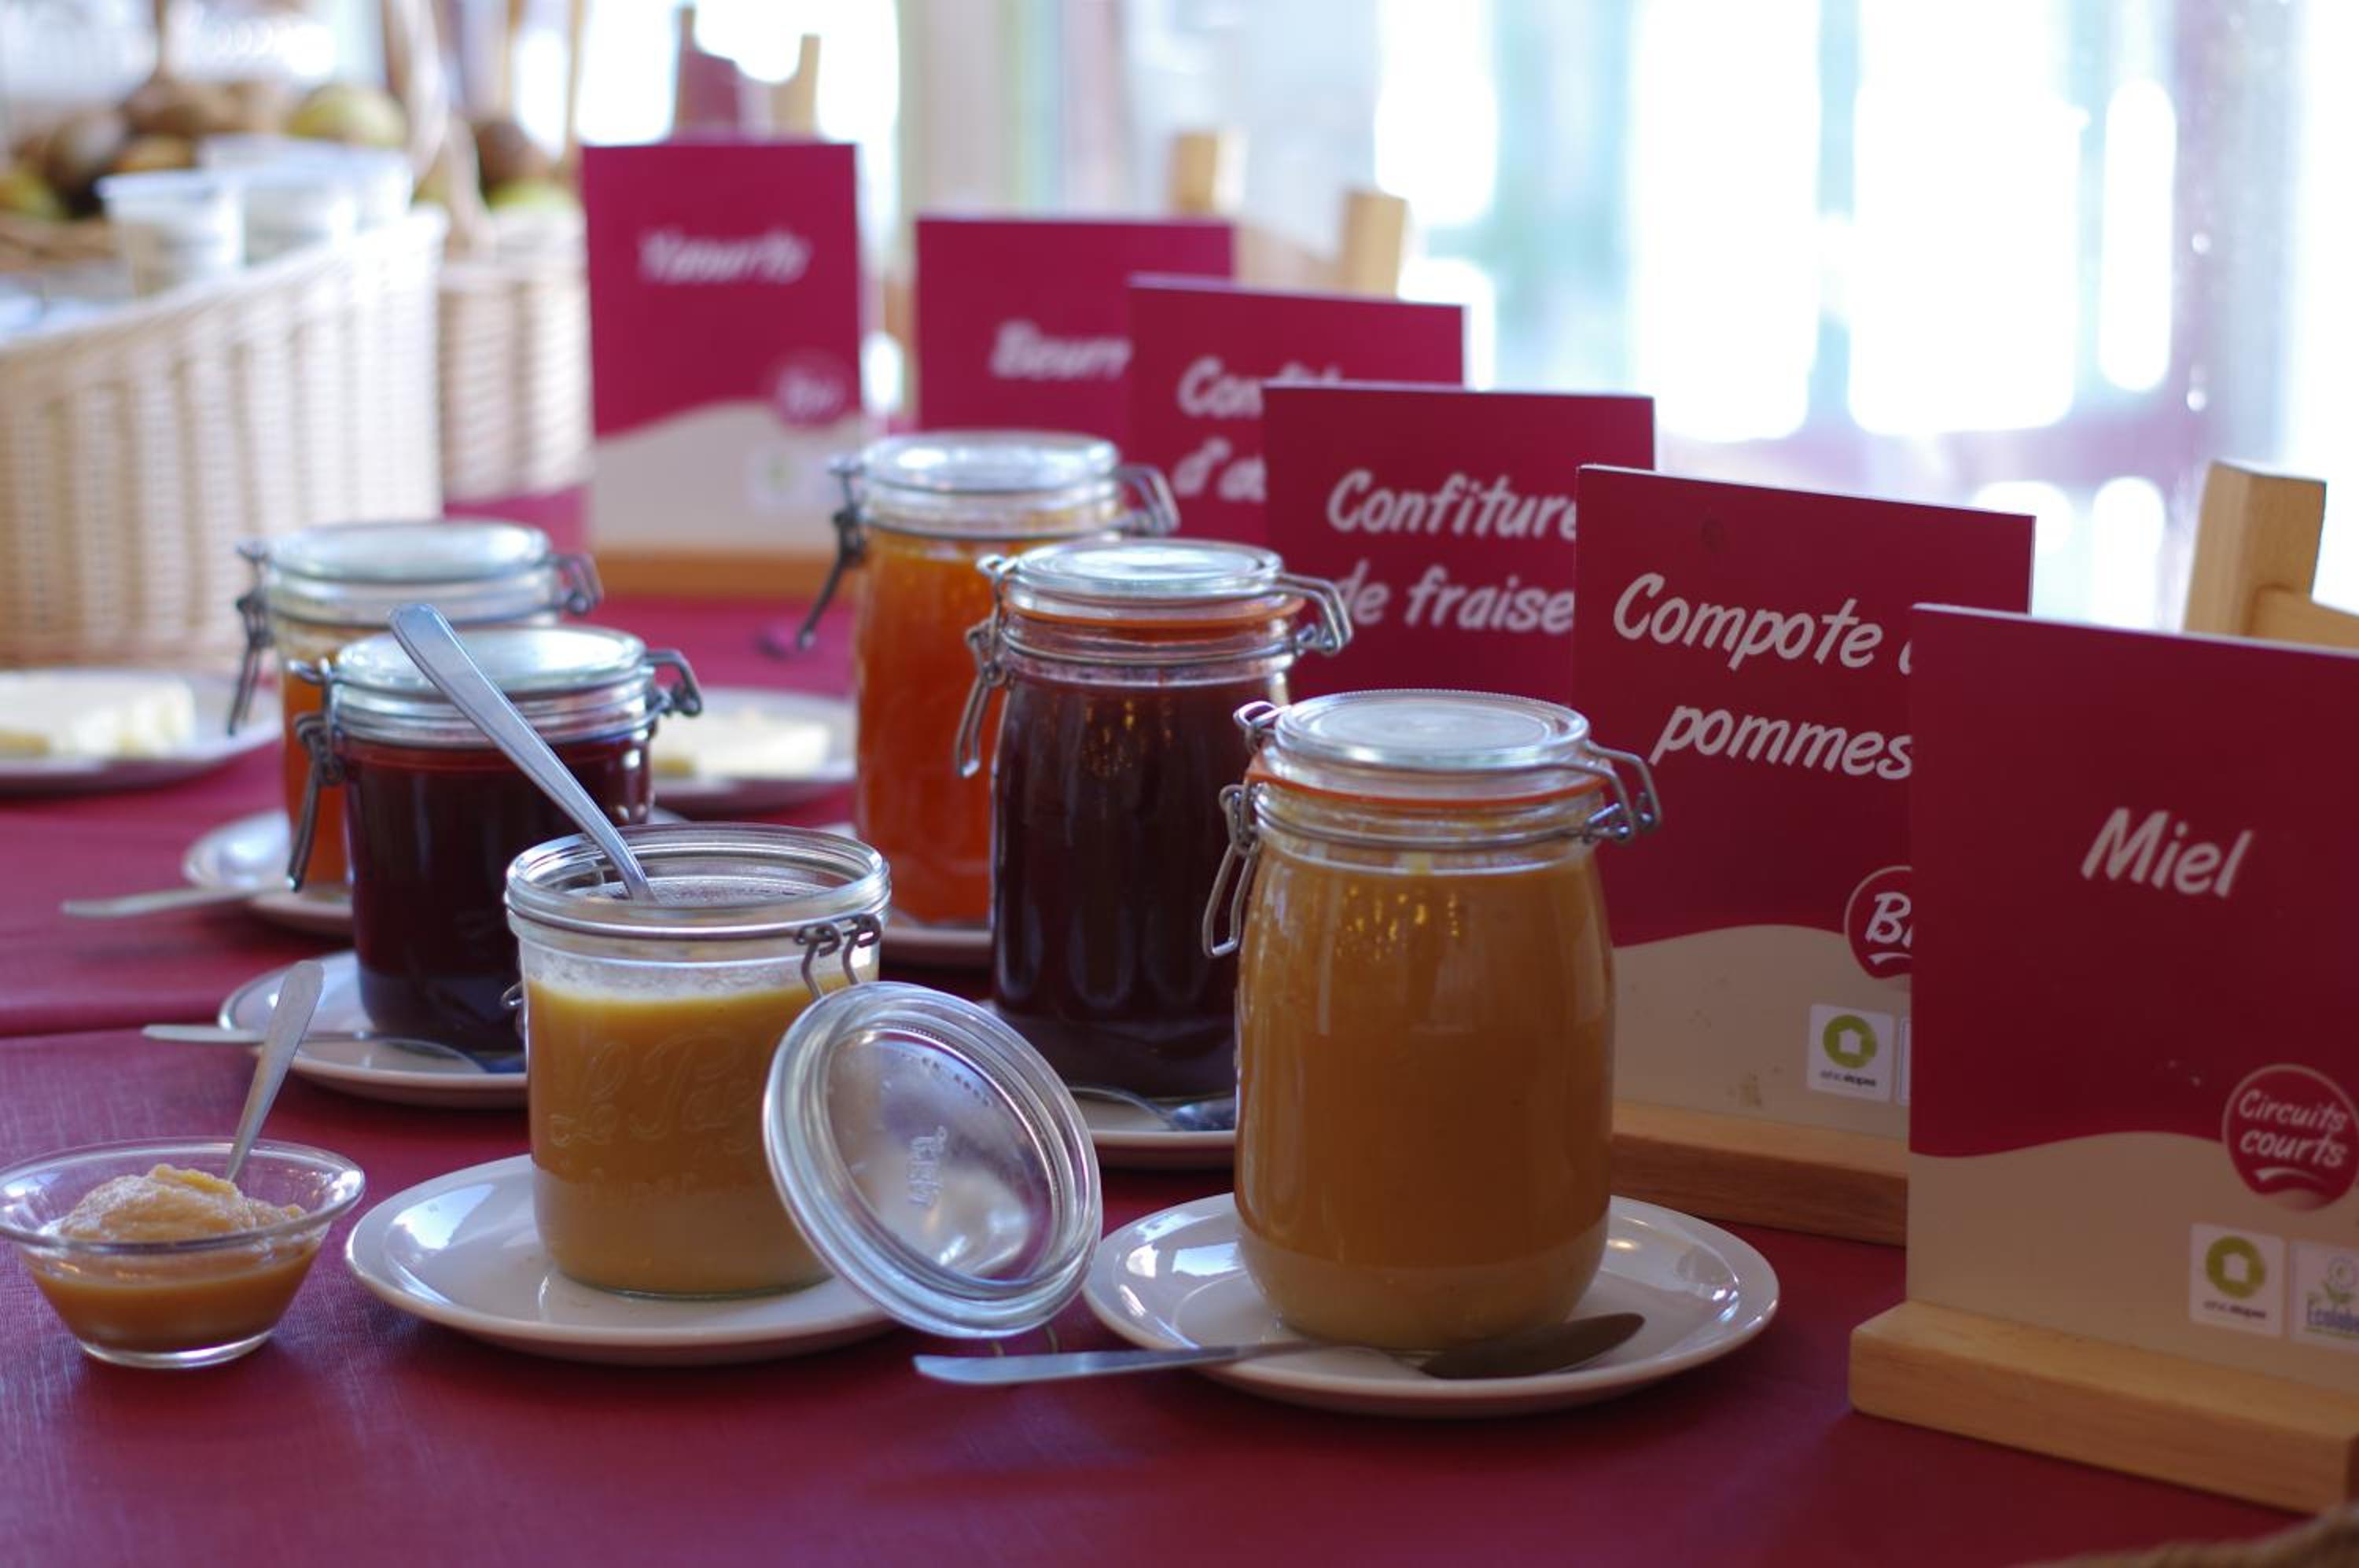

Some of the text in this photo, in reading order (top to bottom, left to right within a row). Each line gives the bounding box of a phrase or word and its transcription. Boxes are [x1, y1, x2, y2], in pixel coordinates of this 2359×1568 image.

[1404, 564, 1574, 634] fraise
[1613, 572, 1883, 671] Compote
[1647, 705, 1912, 780] pommes
[2081, 806, 2253, 899] Miel
[2239, 1088, 2348, 1132] Circuits
[2239, 1129, 2348, 1168] courts
